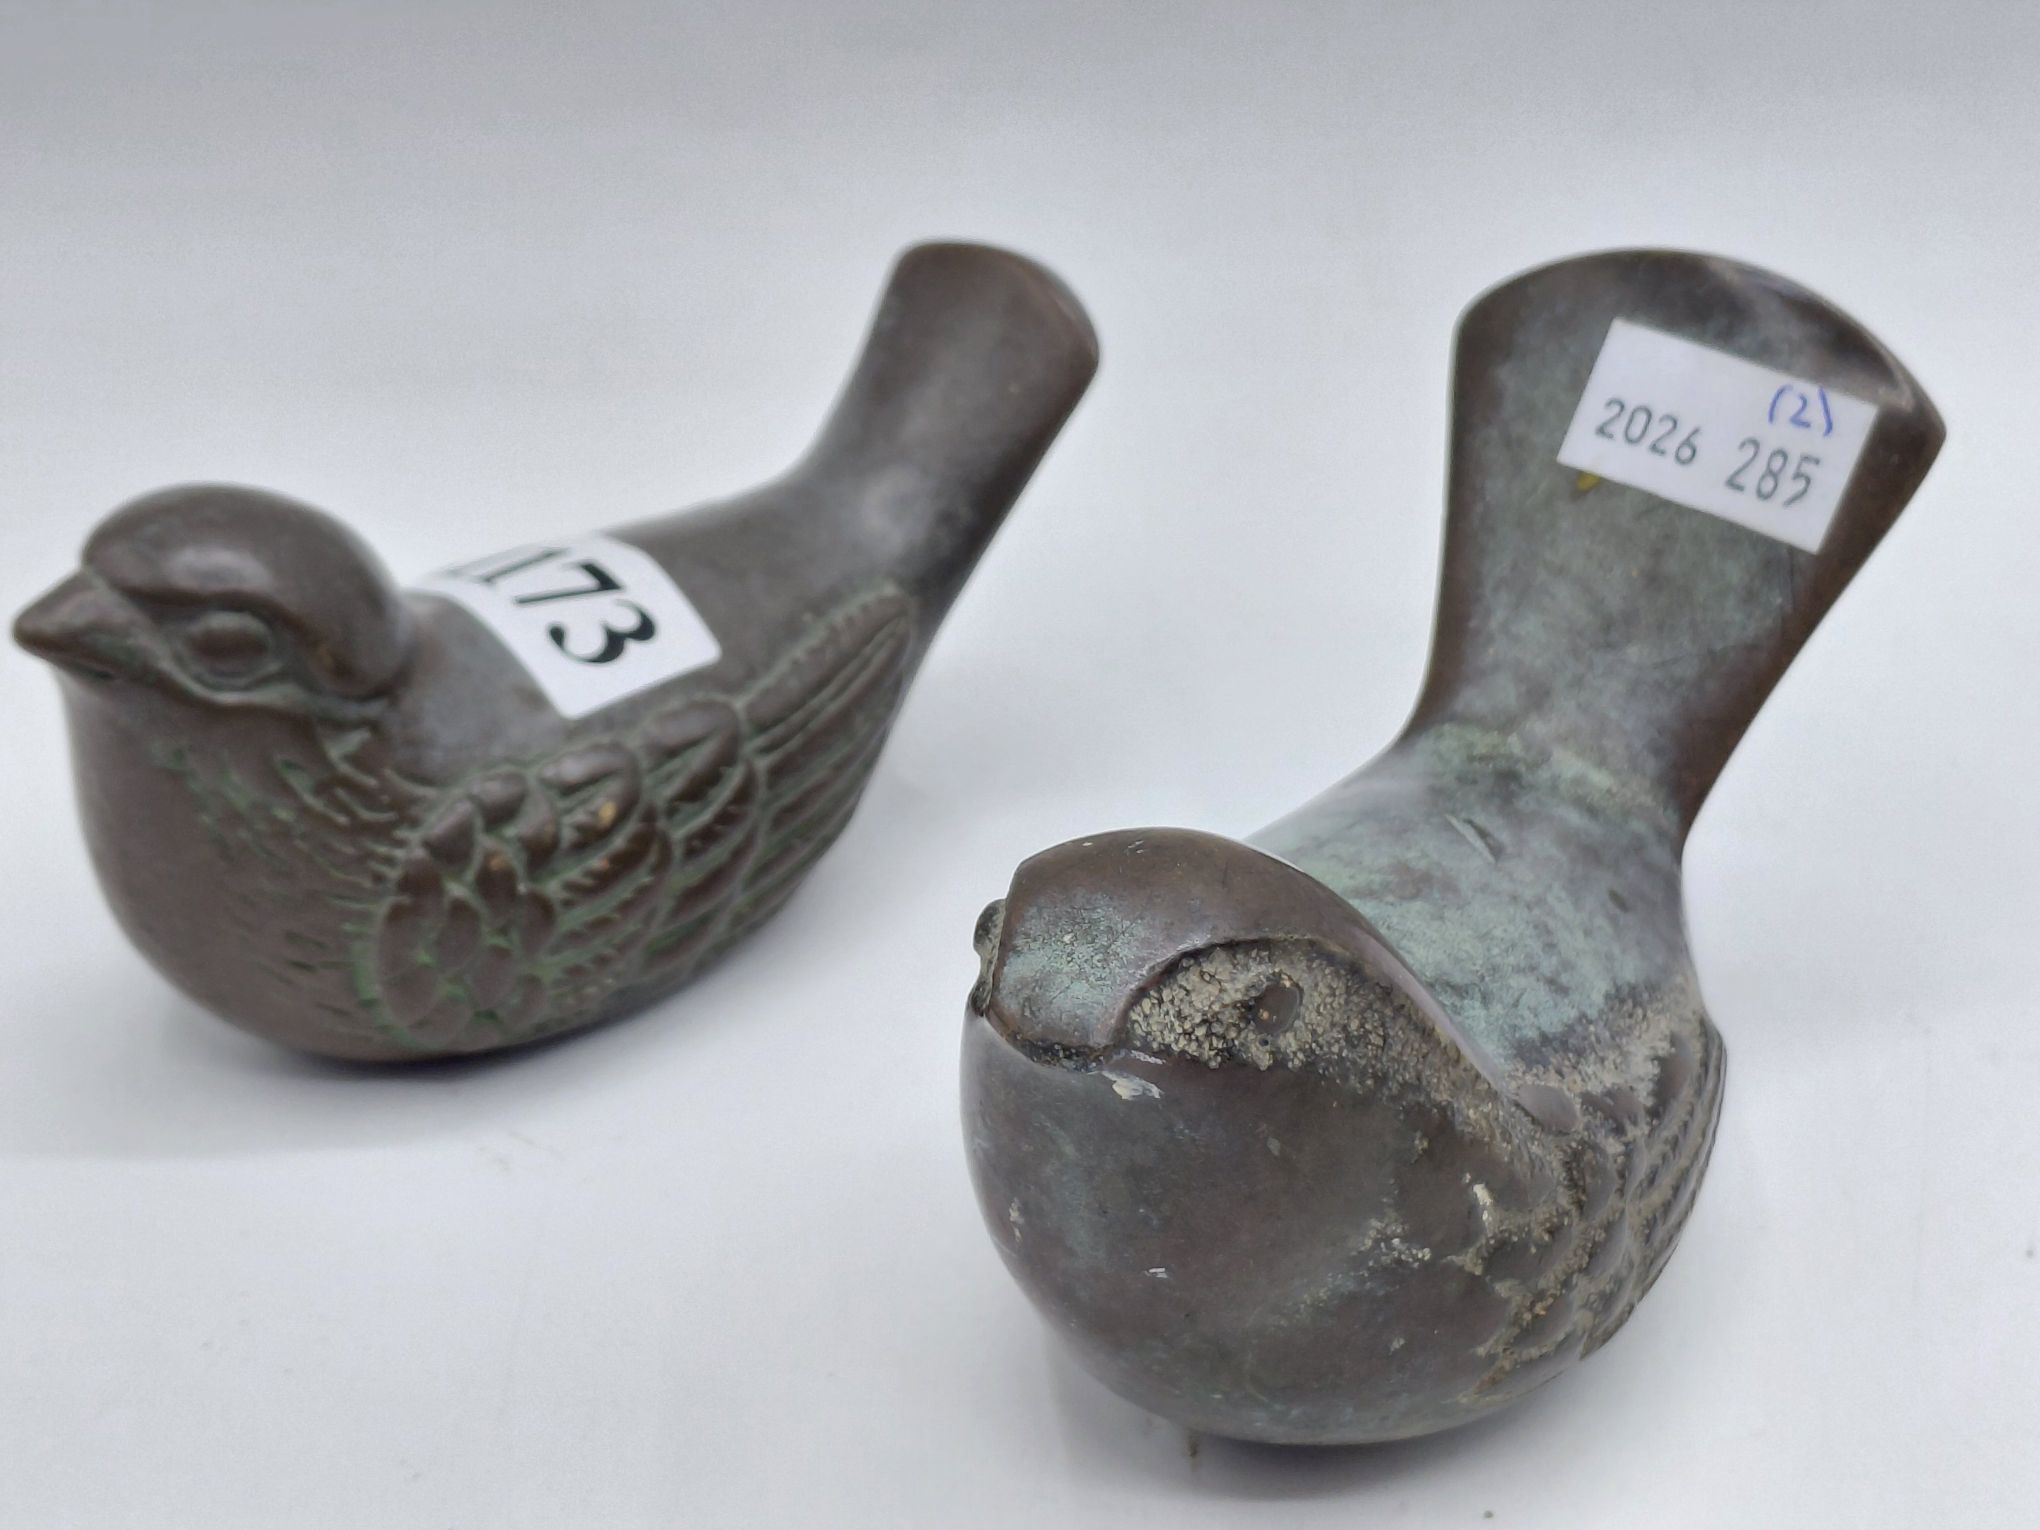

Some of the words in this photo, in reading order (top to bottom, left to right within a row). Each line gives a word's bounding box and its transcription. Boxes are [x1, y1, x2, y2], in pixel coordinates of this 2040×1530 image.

[1767, 383, 1834, 437] (2)
[1594, 397, 1702, 466] 2026
[1724, 437, 1821, 508] 285
